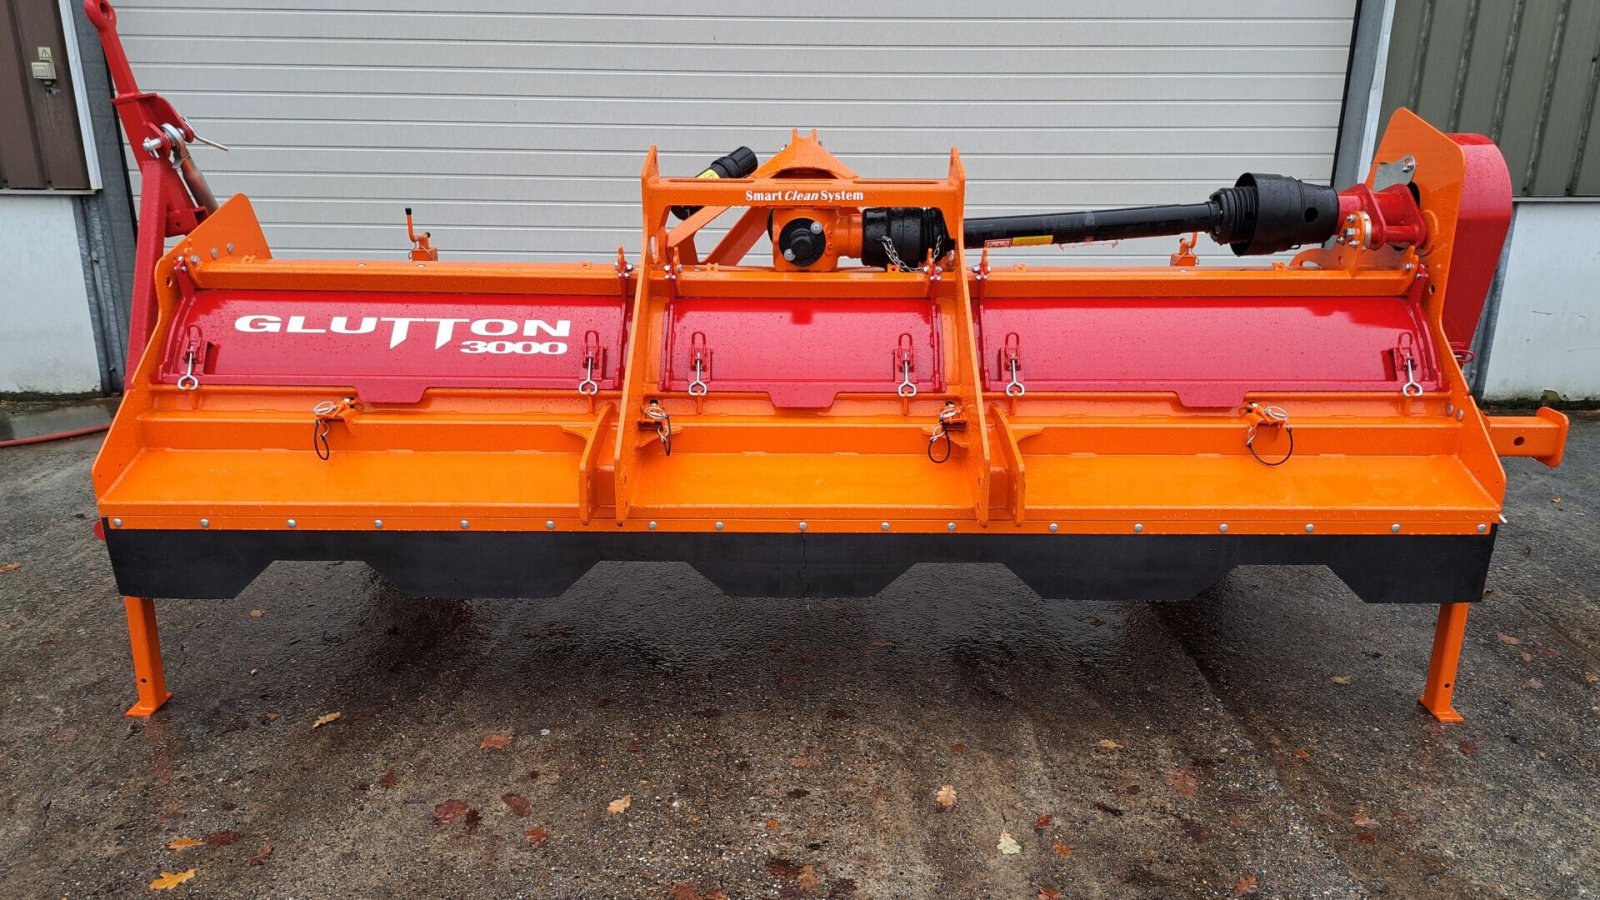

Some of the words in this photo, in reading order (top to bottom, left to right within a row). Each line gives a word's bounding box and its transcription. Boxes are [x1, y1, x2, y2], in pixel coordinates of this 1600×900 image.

[745, 190, 782, 201] Smart
[784, 190, 819, 201] Clean
[820, 189, 864, 202] System
[234, 315, 571, 350] GLUTTON
[459, 340, 568, 355] 3000
